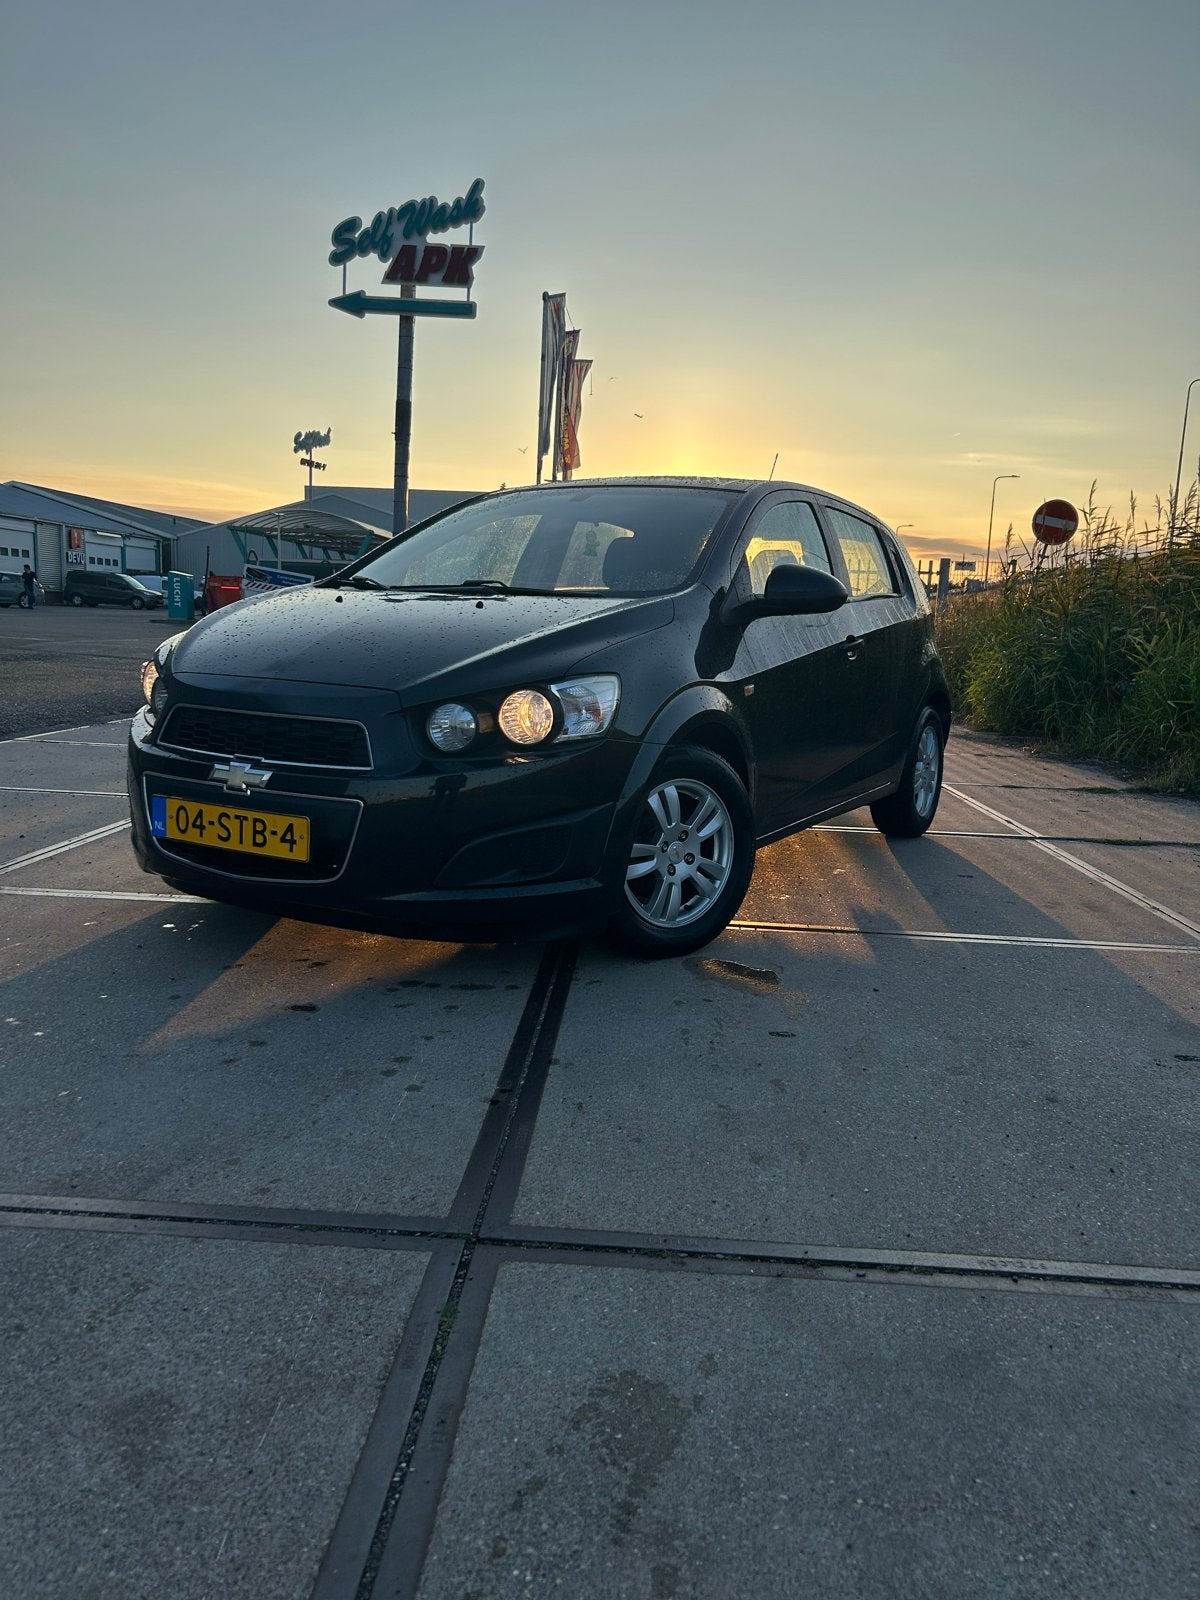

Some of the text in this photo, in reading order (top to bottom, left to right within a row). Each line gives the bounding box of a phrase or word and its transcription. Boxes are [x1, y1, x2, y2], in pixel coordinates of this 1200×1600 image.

[330, 179, 485, 265] Self Wash
[384, 244, 481, 284] APK
[154, 805, 297, 853] NL 04-STB-4
